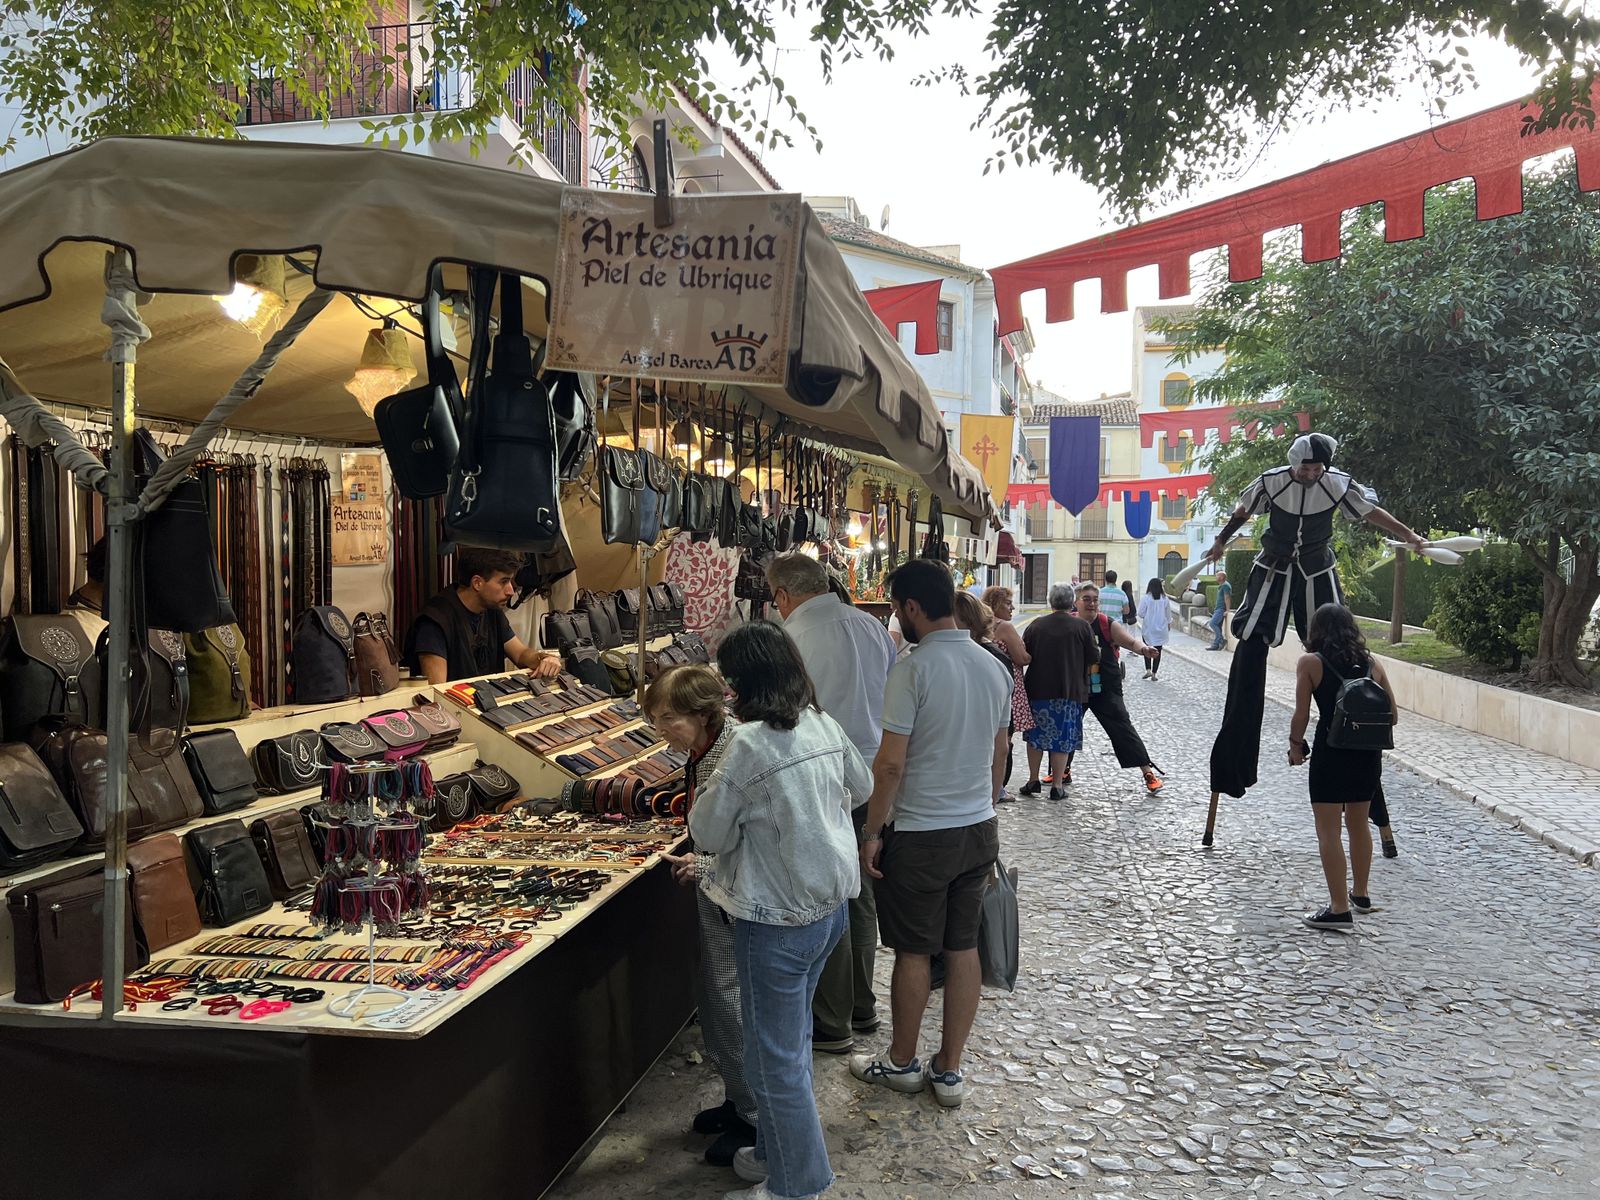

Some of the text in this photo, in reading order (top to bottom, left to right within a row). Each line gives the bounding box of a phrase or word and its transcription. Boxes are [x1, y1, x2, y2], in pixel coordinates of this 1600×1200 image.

[580, 258, 773, 295] Piel de Ubrique
[713, 345, 757, 372] AB
